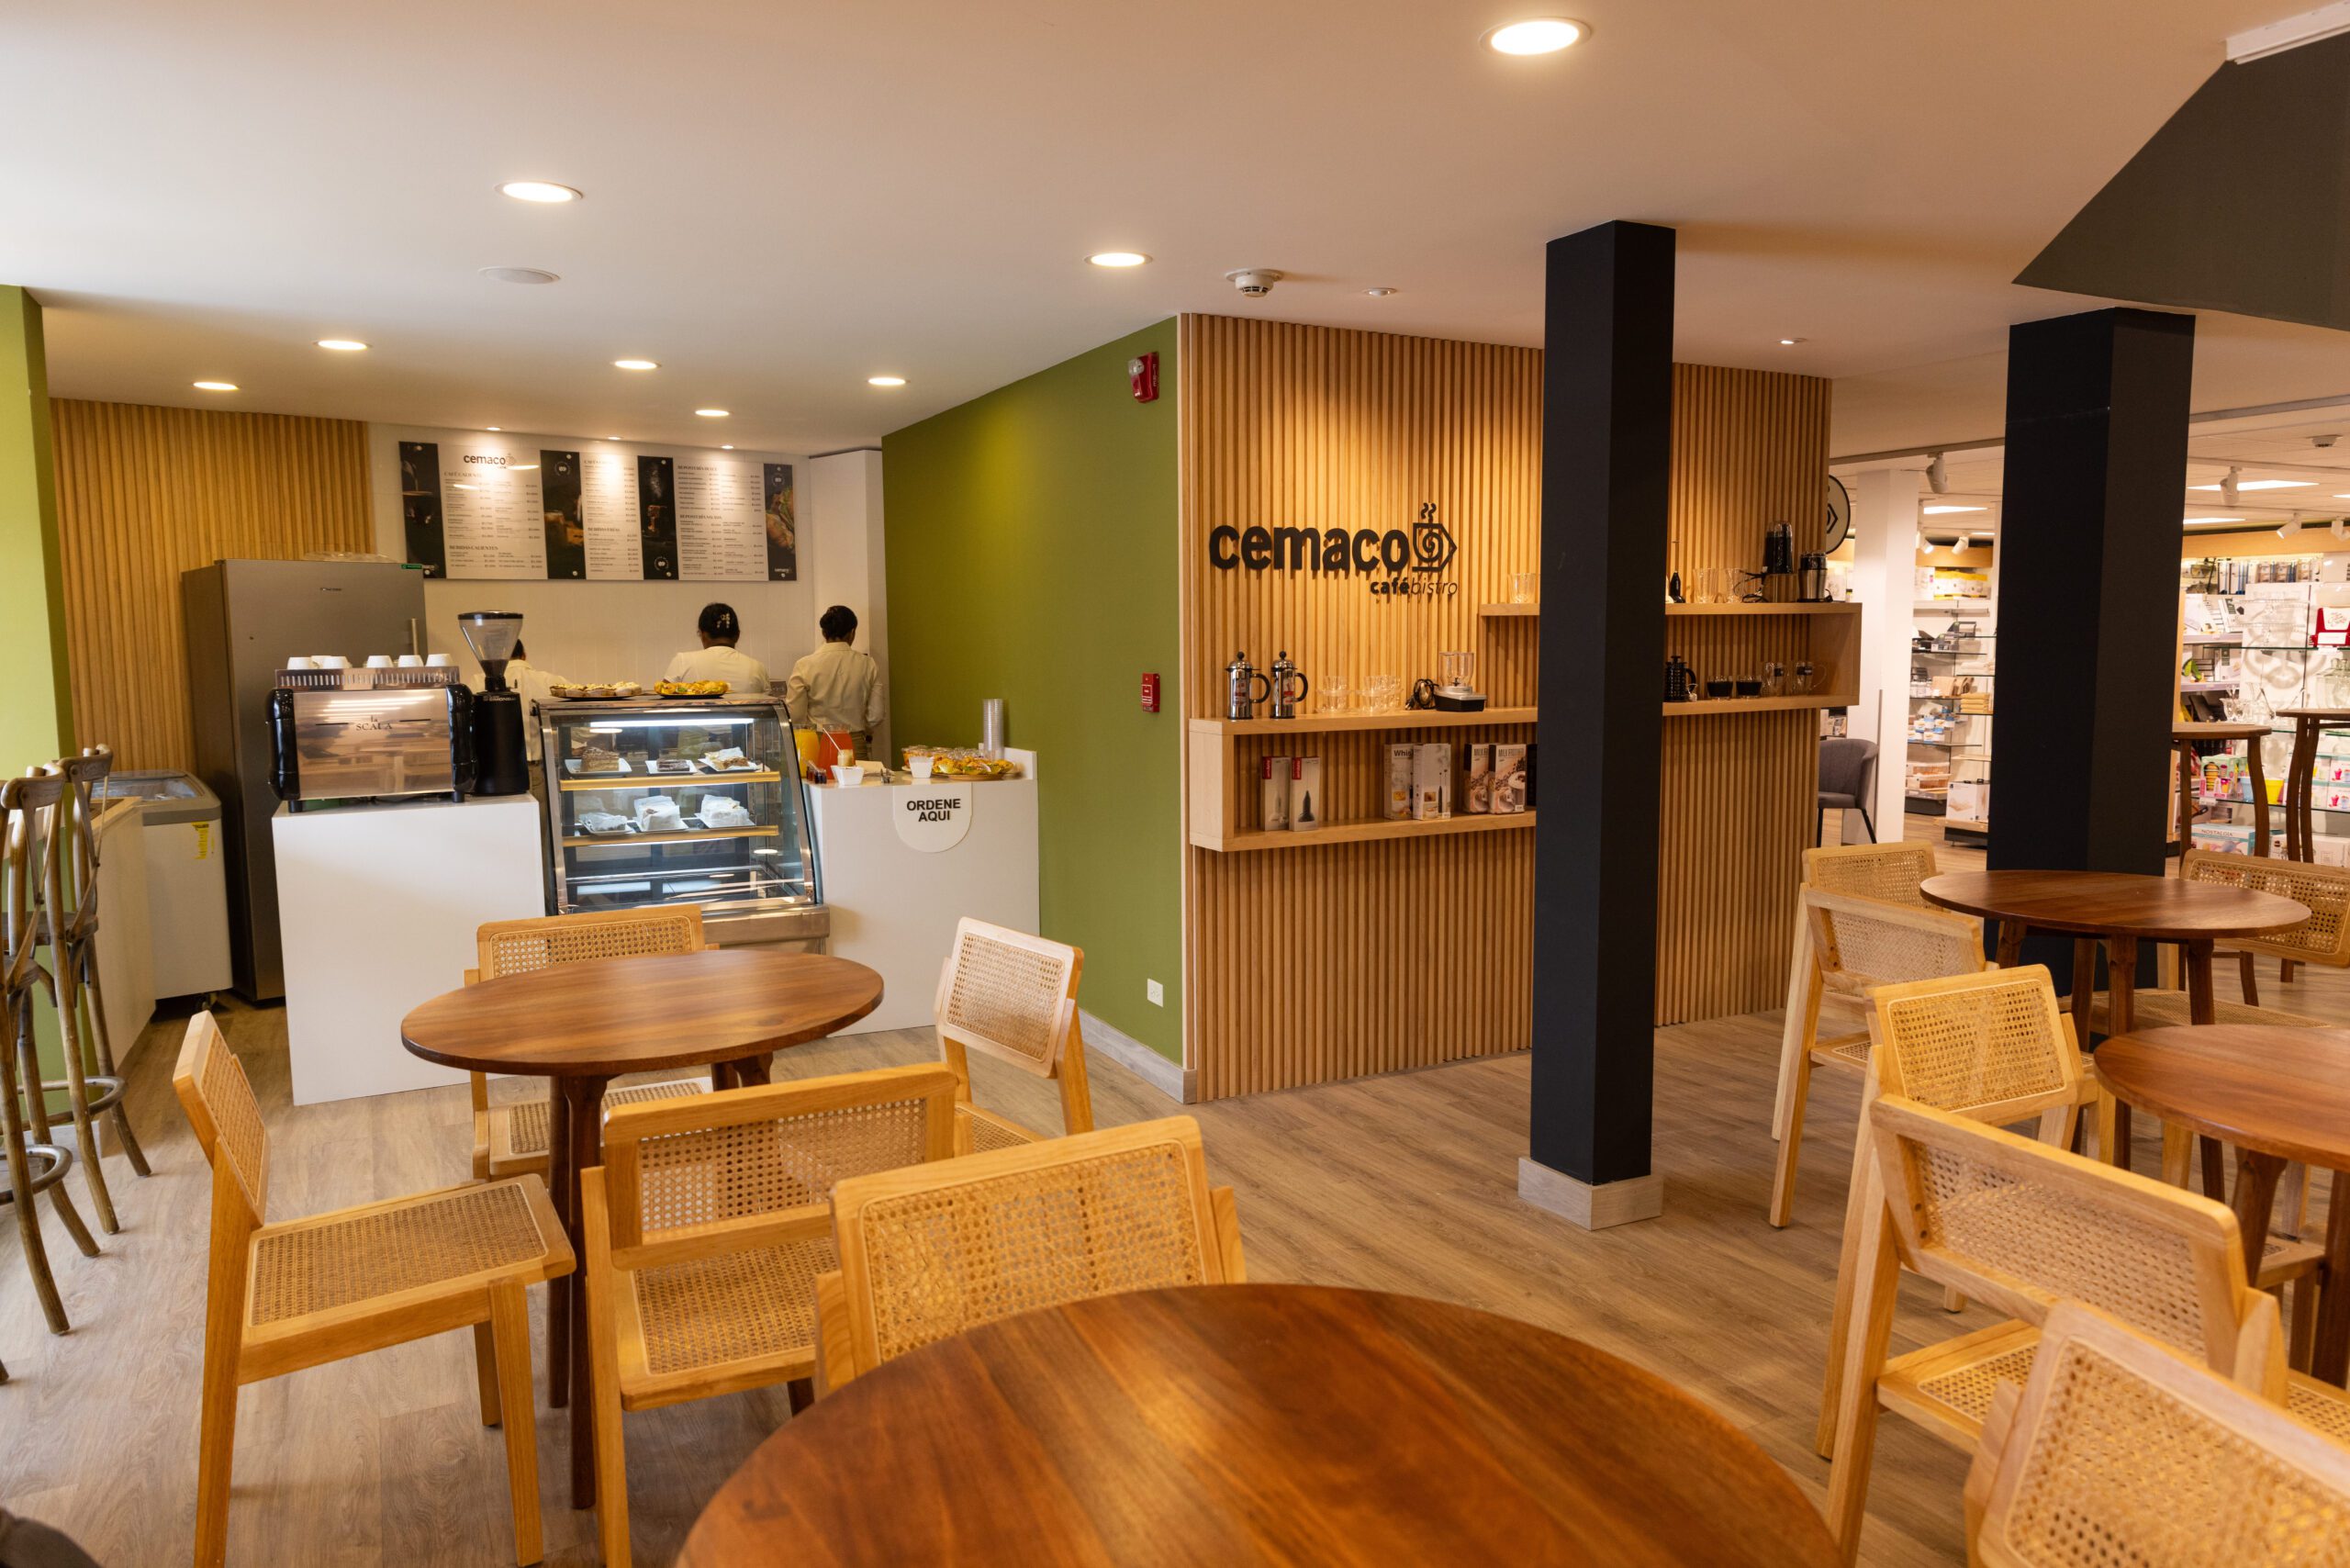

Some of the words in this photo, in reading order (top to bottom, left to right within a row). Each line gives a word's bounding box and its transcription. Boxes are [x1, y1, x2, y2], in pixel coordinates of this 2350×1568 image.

[464, 454, 506, 465] cemaco
[1210, 524, 1411, 572] cemaco
[356, 722, 393, 732] SCALA
[907, 799, 960, 811] ORDENE
[918, 811, 950, 822] AQUI
